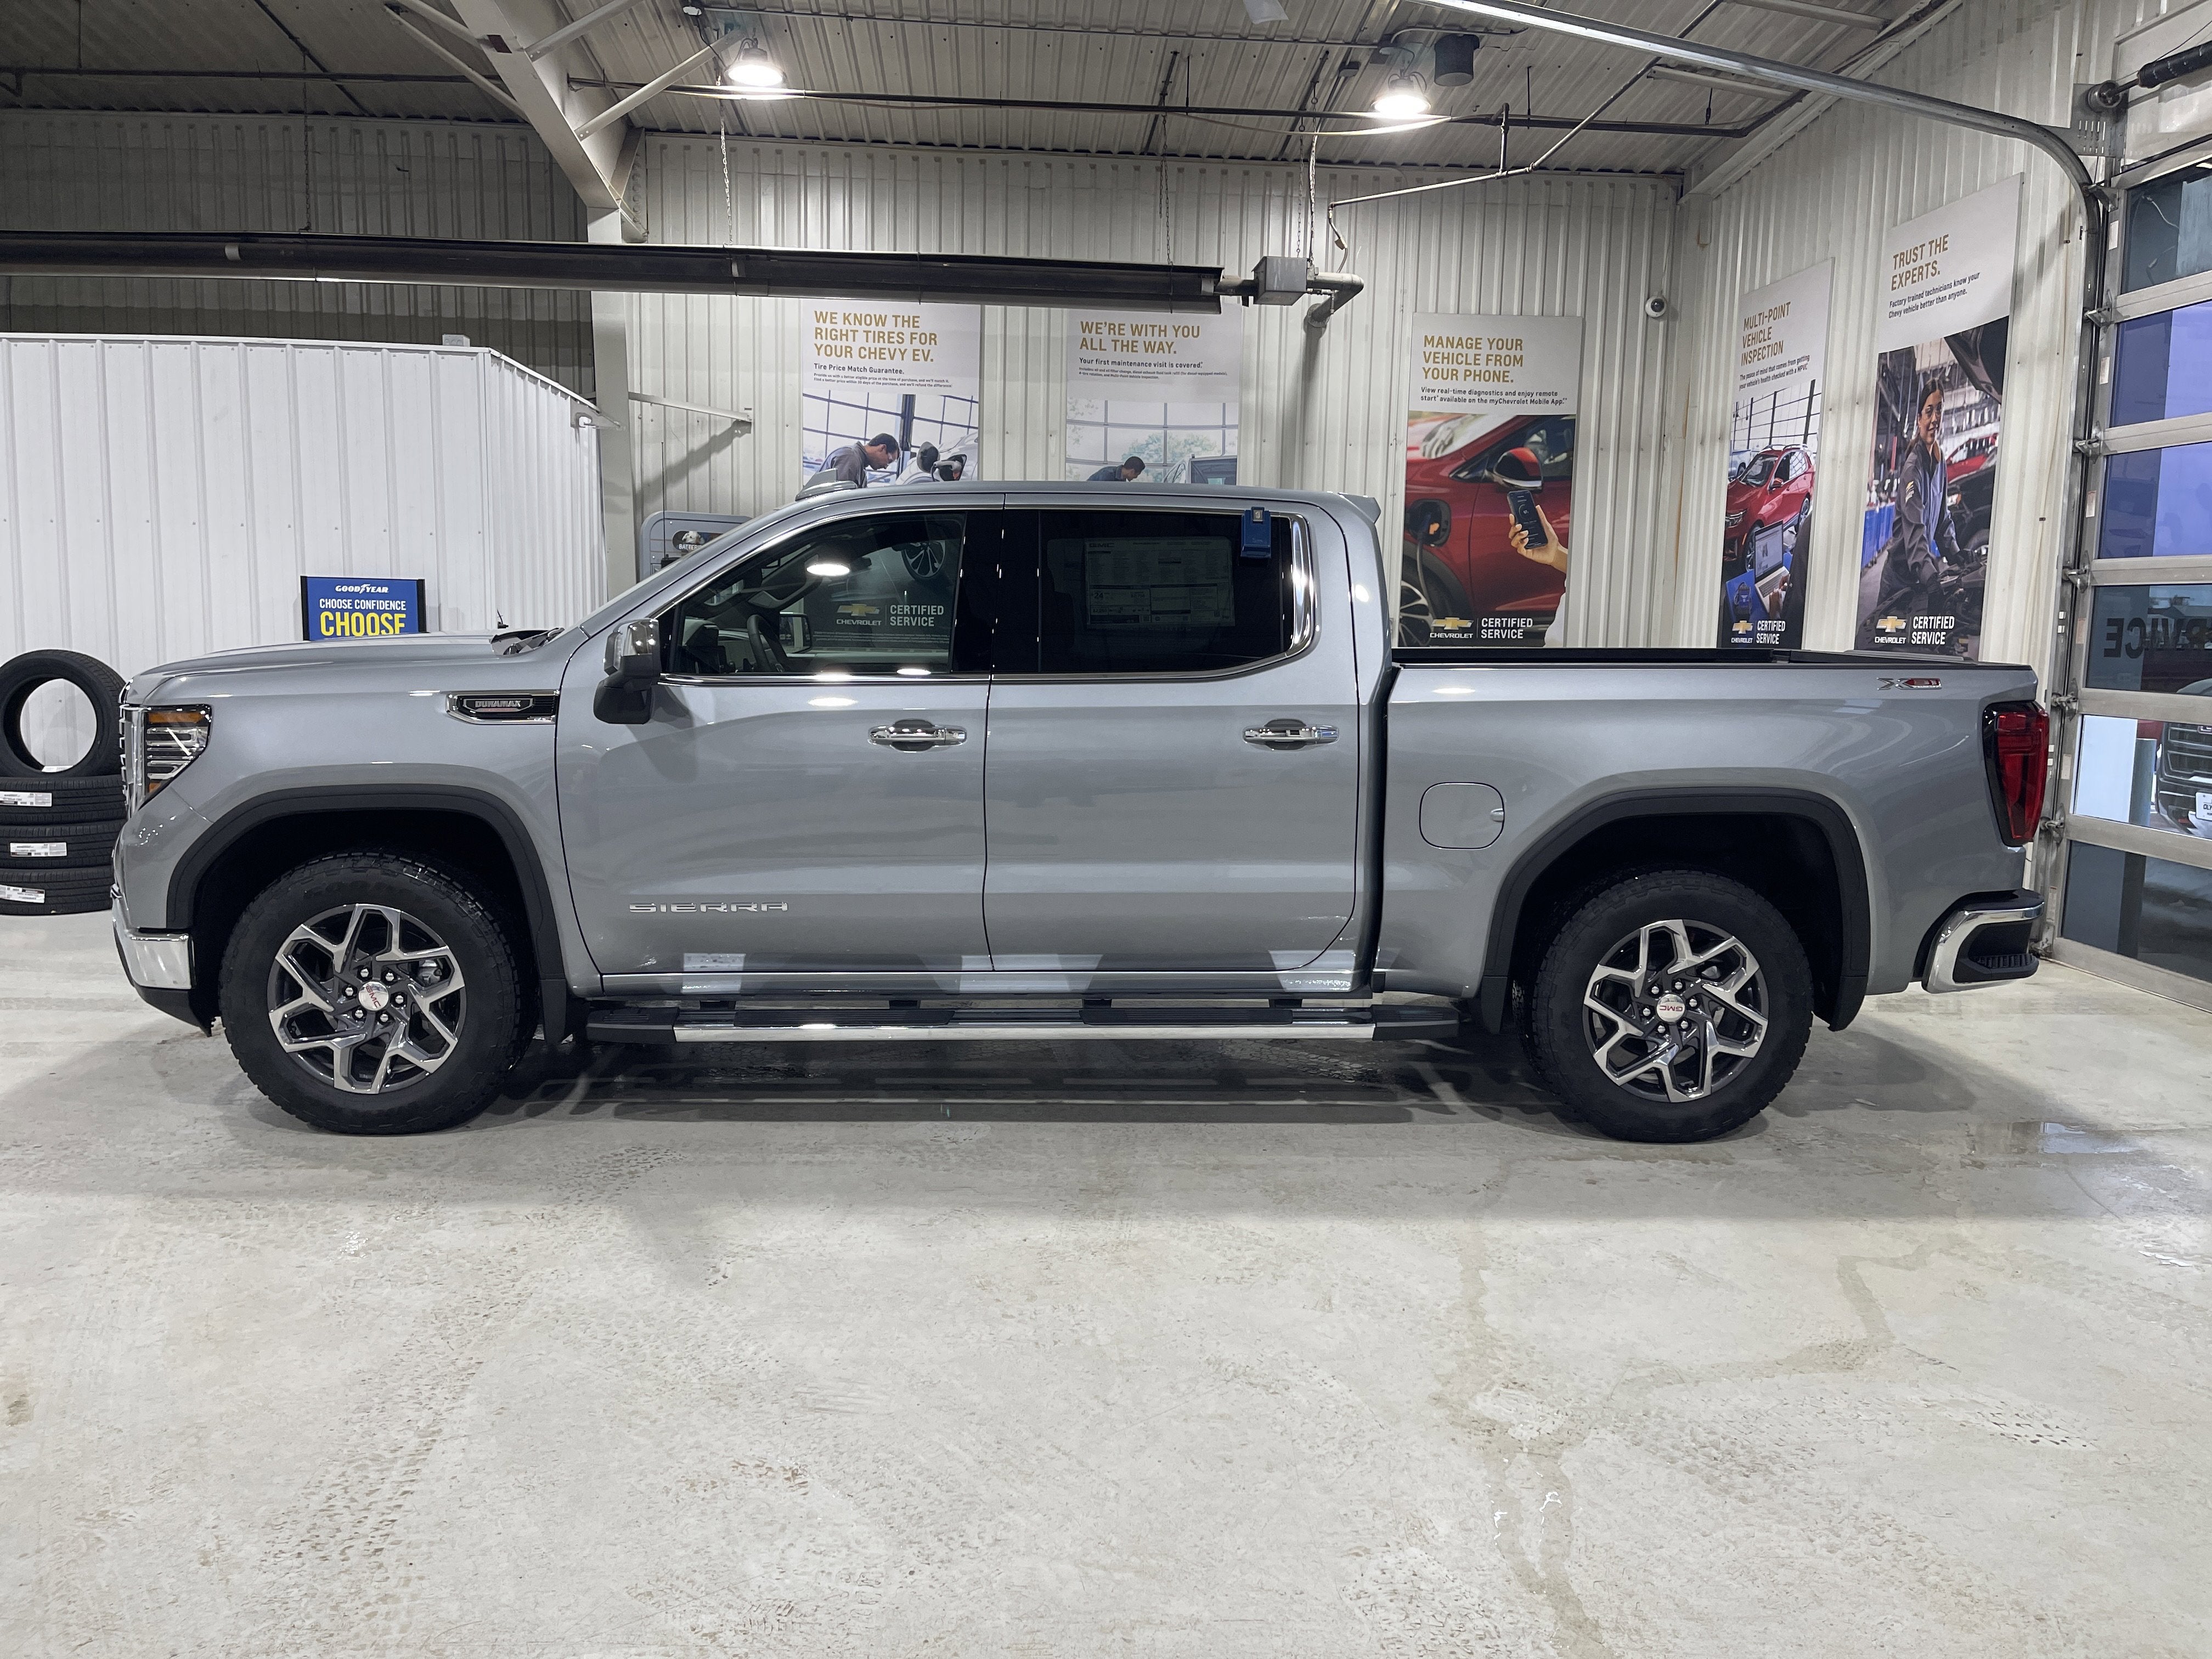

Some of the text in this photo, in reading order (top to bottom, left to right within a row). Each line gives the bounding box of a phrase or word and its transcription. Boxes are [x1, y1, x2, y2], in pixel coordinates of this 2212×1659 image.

[1893, 234, 1949, 270] TRUST THE
[1891, 260, 1940, 291] EXPERTS.
[1889, 272, 1980, 308] Factory trained technicians know your
[1888, 288, 1967, 319] Chevy vehicle better than anyone.
[814, 311, 921, 329] WE KNOW THE
[1743, 301, 1791, 331] MULTI-POINT
[815, 327, 938, 346] RIGHT TIRES FOR
[1080, 321, 1200, 338] WE'RE WITH YOU
[1742, 326, 1773, 348] VEHICLE
[1079, 337, 1177, 354] ALL THE WAY.
[1424, 335, 1523, 351] MANAGE YOUR
[814, 343, 934, 362] YOUR CHEVY EV.
[1423, 351, 1523, 367] VEHICLE FROM
[1741, 340, 1784, 366] INSPECTION
[869, 366, 905, 375] Guarantee.
[1422, 367, 1514, 383] YOUR PHONE.
[335, 584, 389, 594] GOODYEAR
[319, 598, 407, 611] CHOOSE CONFIDENCE
[890, 605, 944, 615] CERTIFIED
[890, 616, 935, 627] SERVICE
[1481, 618, 1533, 628] CERTIFIED
[1757, 620, 1786, 631] CERTIFIED
[1912, 616, 1955, 629] CERTIFIED
[1481, 629, 1523, 639] SERVICE
[1756, 633, 1780, 645] SERVICE
[1911, 631, 1946, 645] SERVICE
[629, 902, 788, 912] SIERRA
[366, 985, 381, 1009] GMC
